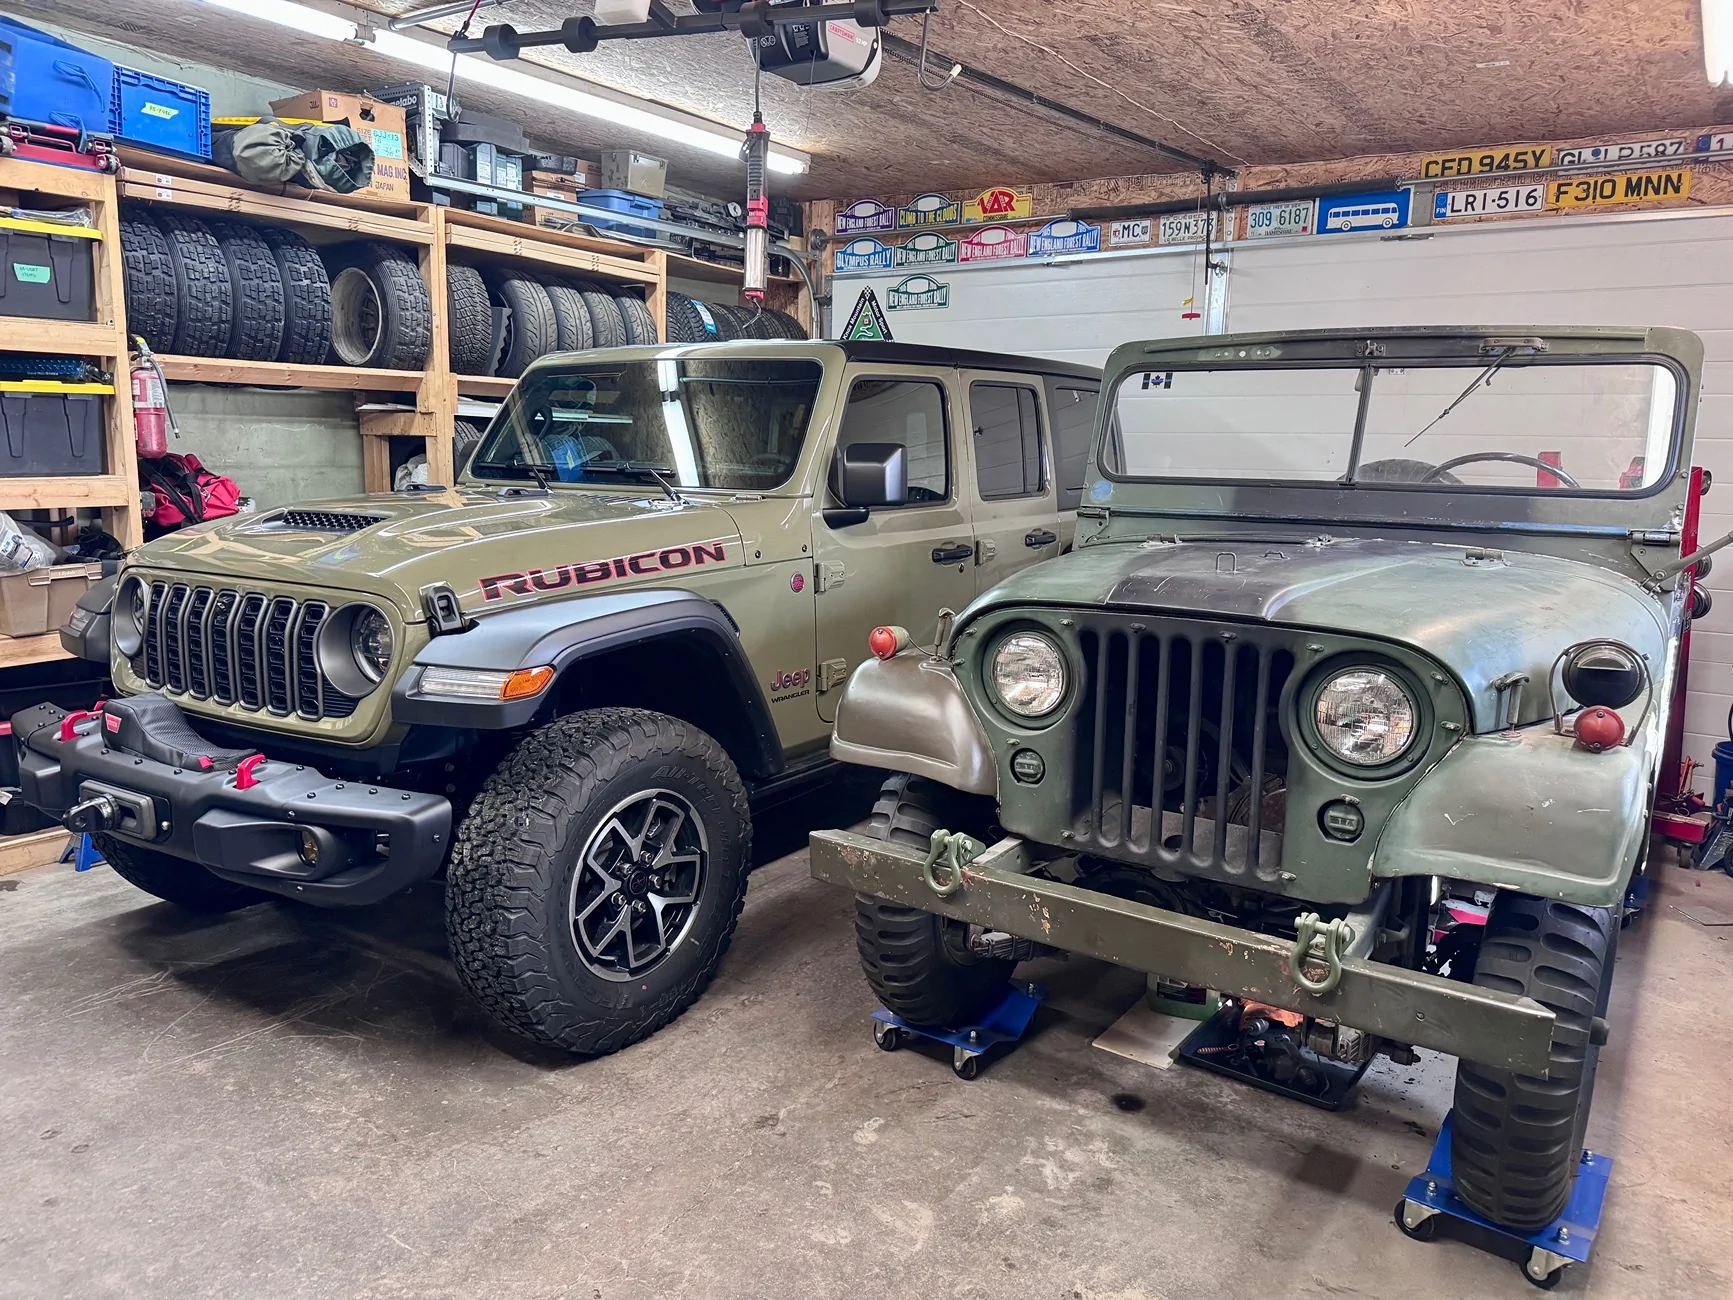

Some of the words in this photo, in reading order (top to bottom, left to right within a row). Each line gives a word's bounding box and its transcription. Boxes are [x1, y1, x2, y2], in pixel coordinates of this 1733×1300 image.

[830, 24, 853, 40] CRAFTSMAN
[1478, 148, 1546, 174] 945Y
[376, 181, 394, 192] JAPAN
[1555, 178, 1616, 203] F310
[1624, 173, 1682, 198] MNN
[976, 190, 1016, 214] VAR
[838, 216, 846, 230] NEW
[846, 218, 864, 229] ENGLAND
[864, 215, 879, 228] FOREST
[880, 210, 892, 226] RALLY
[900, 210, 916, 225] CLIMB
[918, 212, 924, 224] TO
[926, 210, 936, 222] THE
[936, 204, 958, 222] CLOUDS
[1250, 211, 1272, 228] 309
[1279, 207, 1309, 226] 6187
[1030, 238, 1040, 252] NEW
[1042, 238, 1064, 251] ENGLAND
[1064, 236, 1082, 249] FOREST
[1082, 229, 1098, 247] RALLY
[1122, 224, 1140, 238] MC
[836, 252, 868, 268] OLYMPUS
[870, 248, 891, 266] RALLY
[896, 252, 906, 263] NEW
[906, 252, 926, 262] ENGLAND
[926, 249, 941, 261] FOREST
[942, 242, 956, 260] RALLY
[962, 244, 972, 258] NEW
[972, 244, 992, 258] ENGLAND
[992, 242, 1010, 256] FOREST
[1010, 237, 1026, 254] RALLY
[888, 294, 898, 306] NEW
[899, 294, 918, 306] ENGLAND
[918, 292, 933, 304] FOREST
[934, 288, 946, 303] RALLY
[842, 324, 852, 340] Knox
[850, 298, 864, 326] Mountain
[872, 300, 881, 318] Motor
[878, 317, 888, 334] Sport
[478, 542, 726, 602] RUBICON
[770, 668, 810, 692] Jeep
[770, 690, 810, 704] WRANGLER
